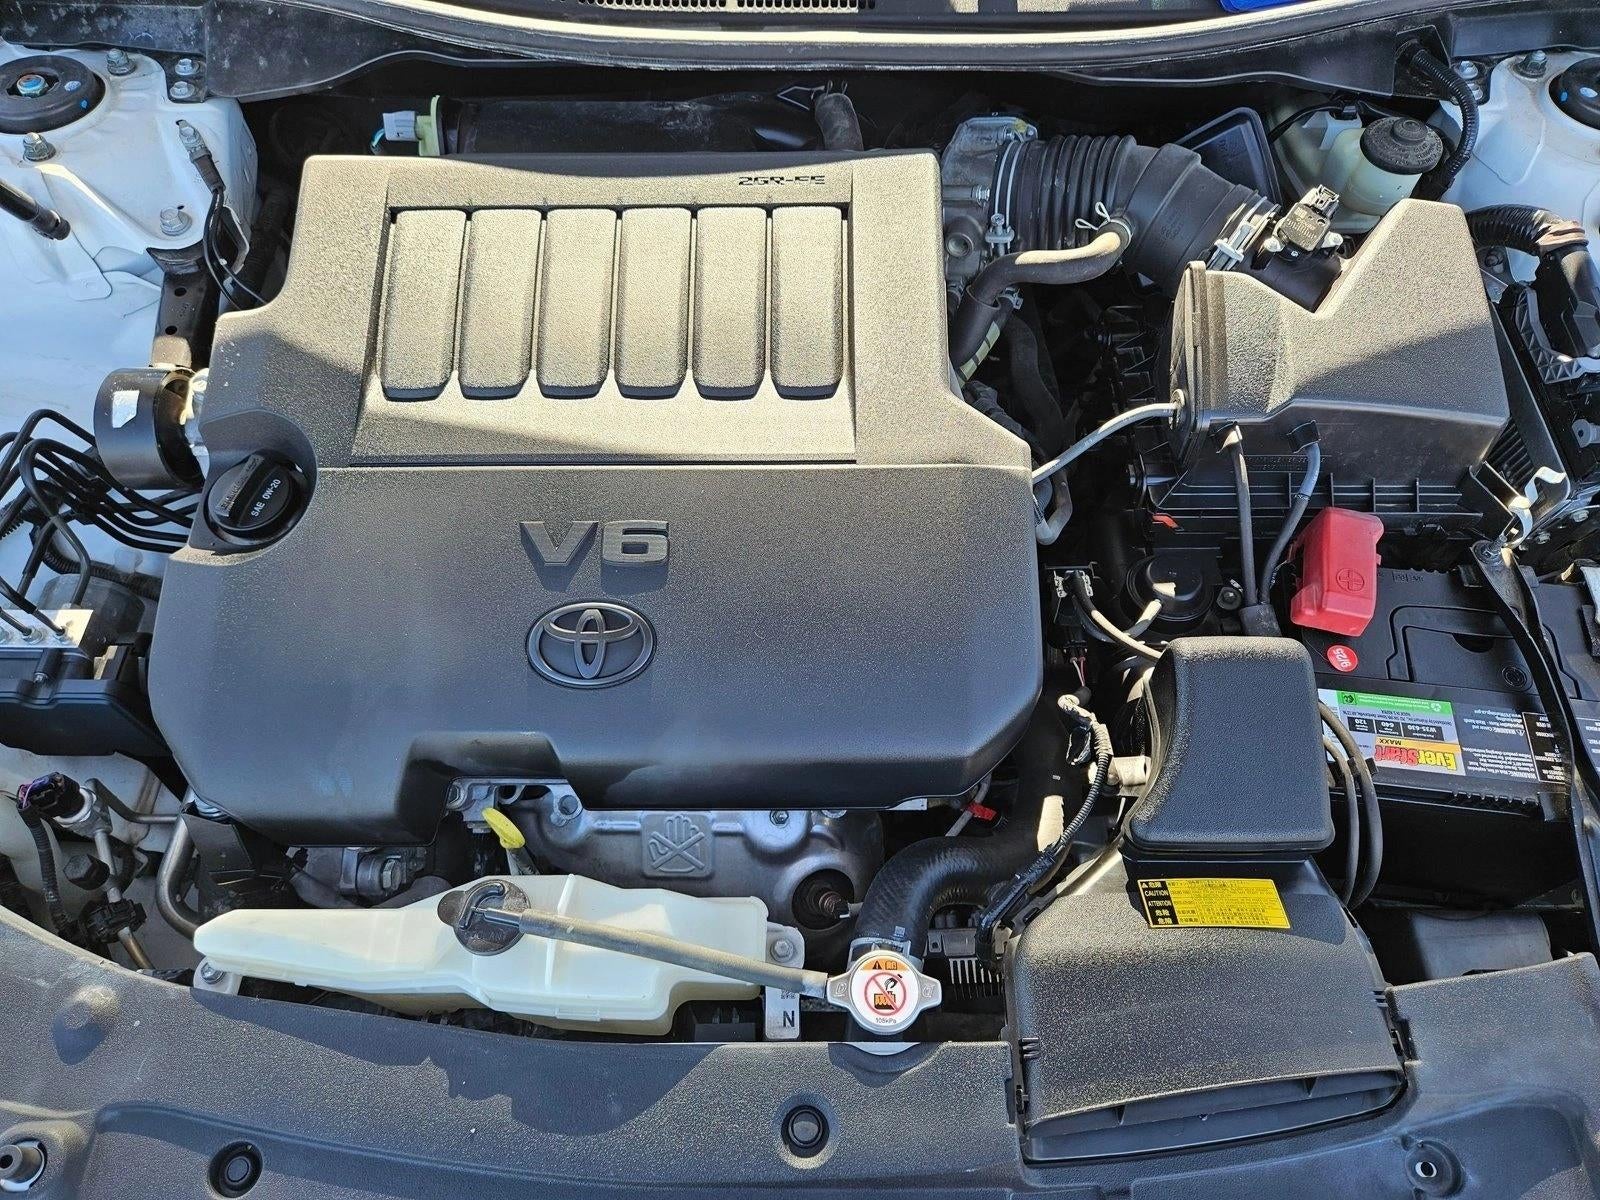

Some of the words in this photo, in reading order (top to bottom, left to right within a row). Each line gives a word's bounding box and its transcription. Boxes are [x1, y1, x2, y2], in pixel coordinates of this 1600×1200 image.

[738, 175, 826, 186] 2GR-FE
[250, 501, 266, 516] SAE
[263, 478, 282, 500] 0W-20
[518, 519, 670, 567] V6
[1374, 745, 1457, 771] EverStart
[782, 1010, 795, 1028] N
